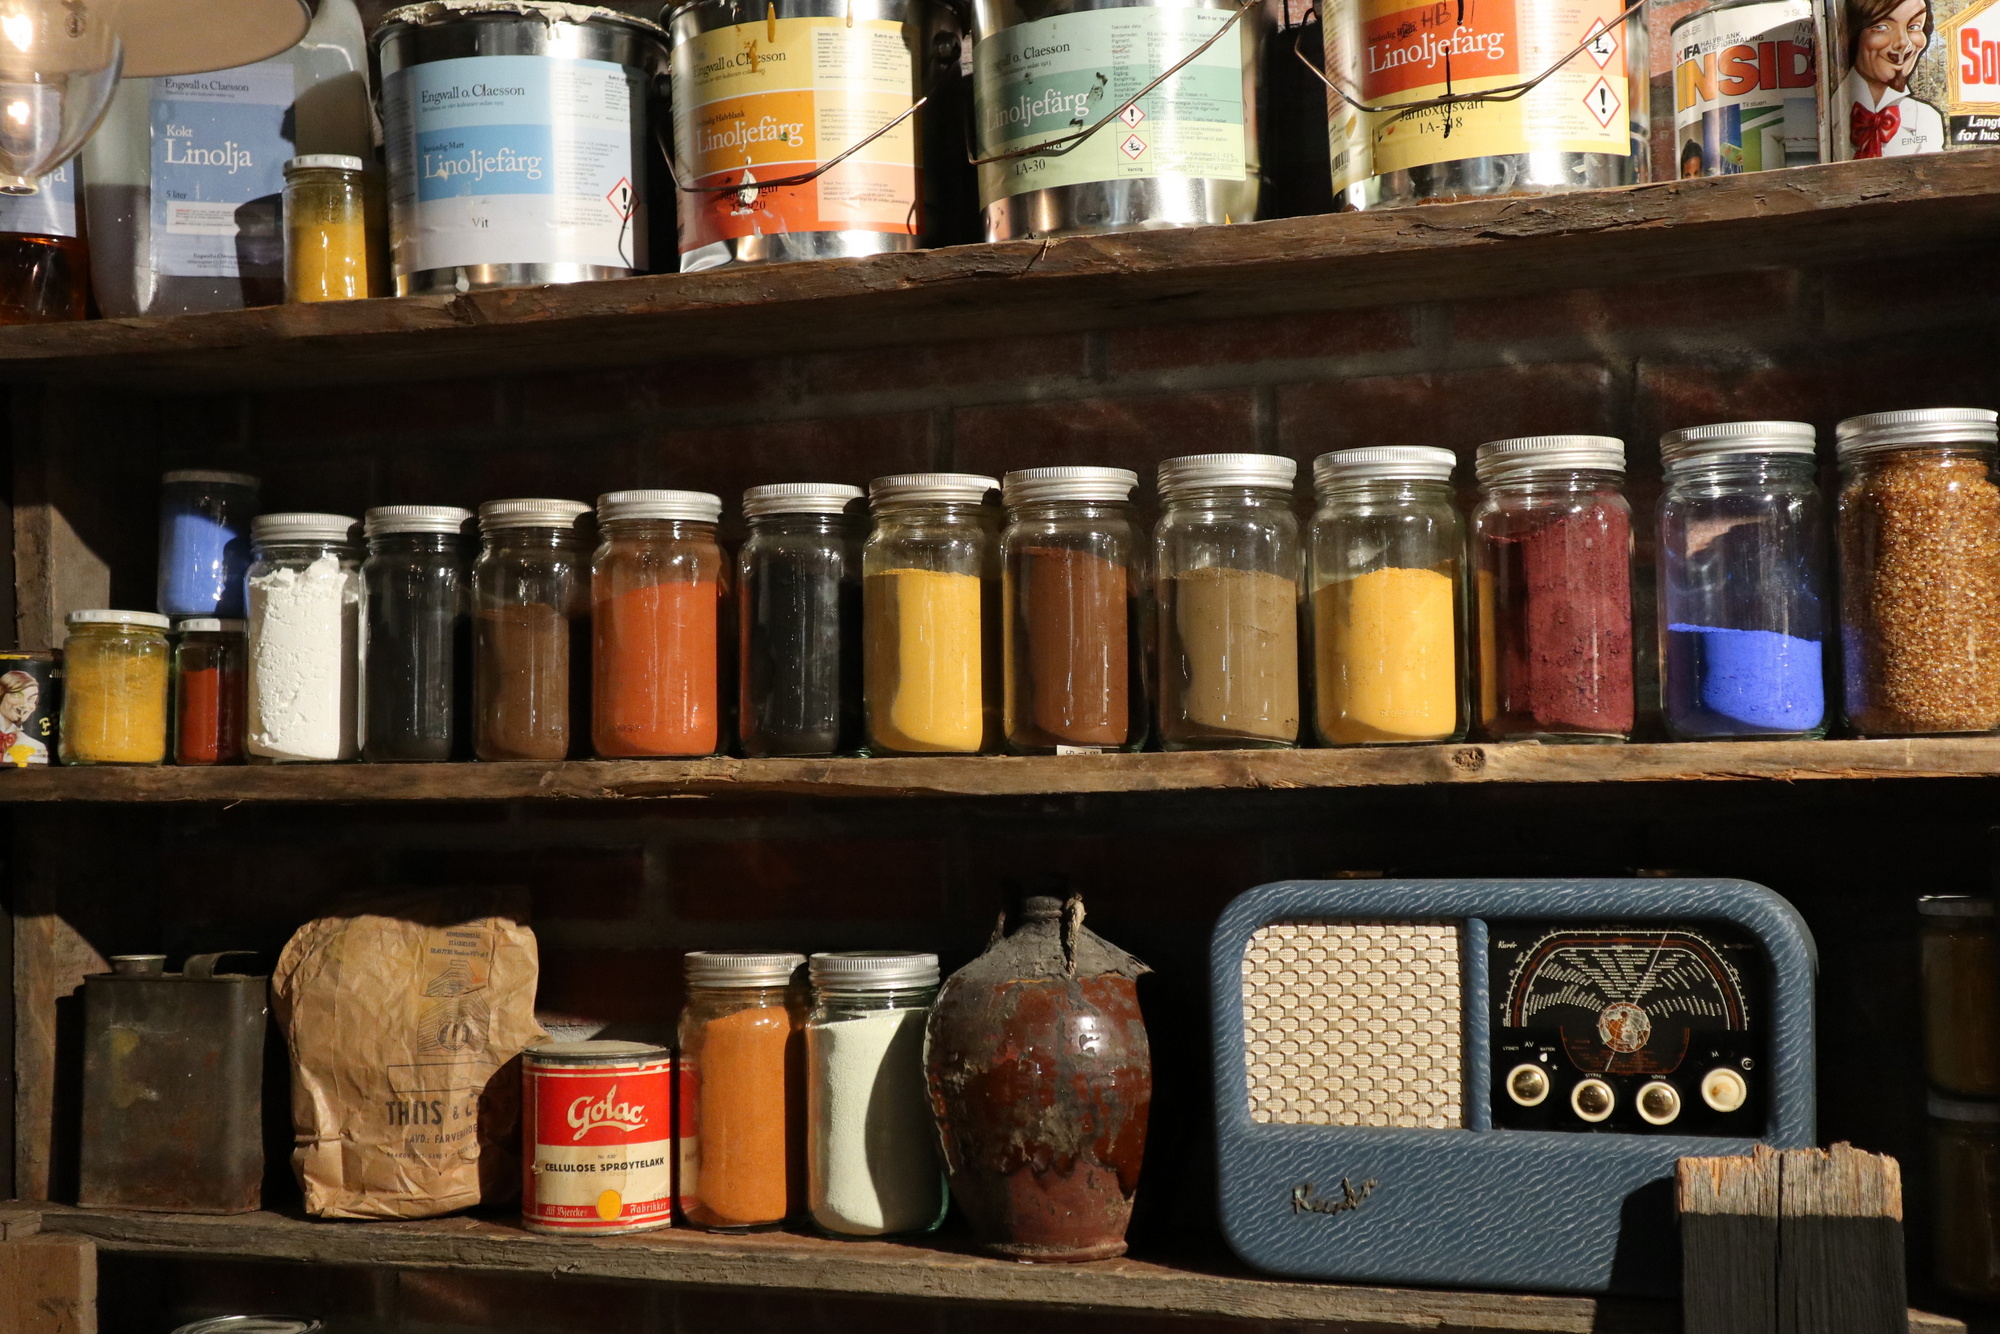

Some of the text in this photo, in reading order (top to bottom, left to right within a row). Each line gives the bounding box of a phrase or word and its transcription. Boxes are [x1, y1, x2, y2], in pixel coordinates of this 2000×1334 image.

[1701, 31, 1742, 47] HALVBLANK
[1013, 54, 1021, 62] o.
[1023, 43, 1070, 60] Claesson
[1369, 26, 1504, 73] Linoljefärg
[1684, 43, 1701, 60] IFA
[421, 84, 525, 105] Engwall o. Claesson
[986, 88, 1090, 133] Linoljefärg
[166, 124, 192, 137] Kokt
[697, 116, 804, 154] Linoljefärg
[1957, 129, 1999, 141] for hus
[164, 139, 253, 175] Linolja
[424, 147, 542, 181] Linoljefärg
[166, 190, 187, 199] 5 liter
[472, 218, 488, 228] Vit
[545, 1157, 665, 1173] CELLULOSE SPRØYTELAKK
[545, 1206, 556, 1217] Alf
[630, 1201, 667, 1215] Fabrikker
